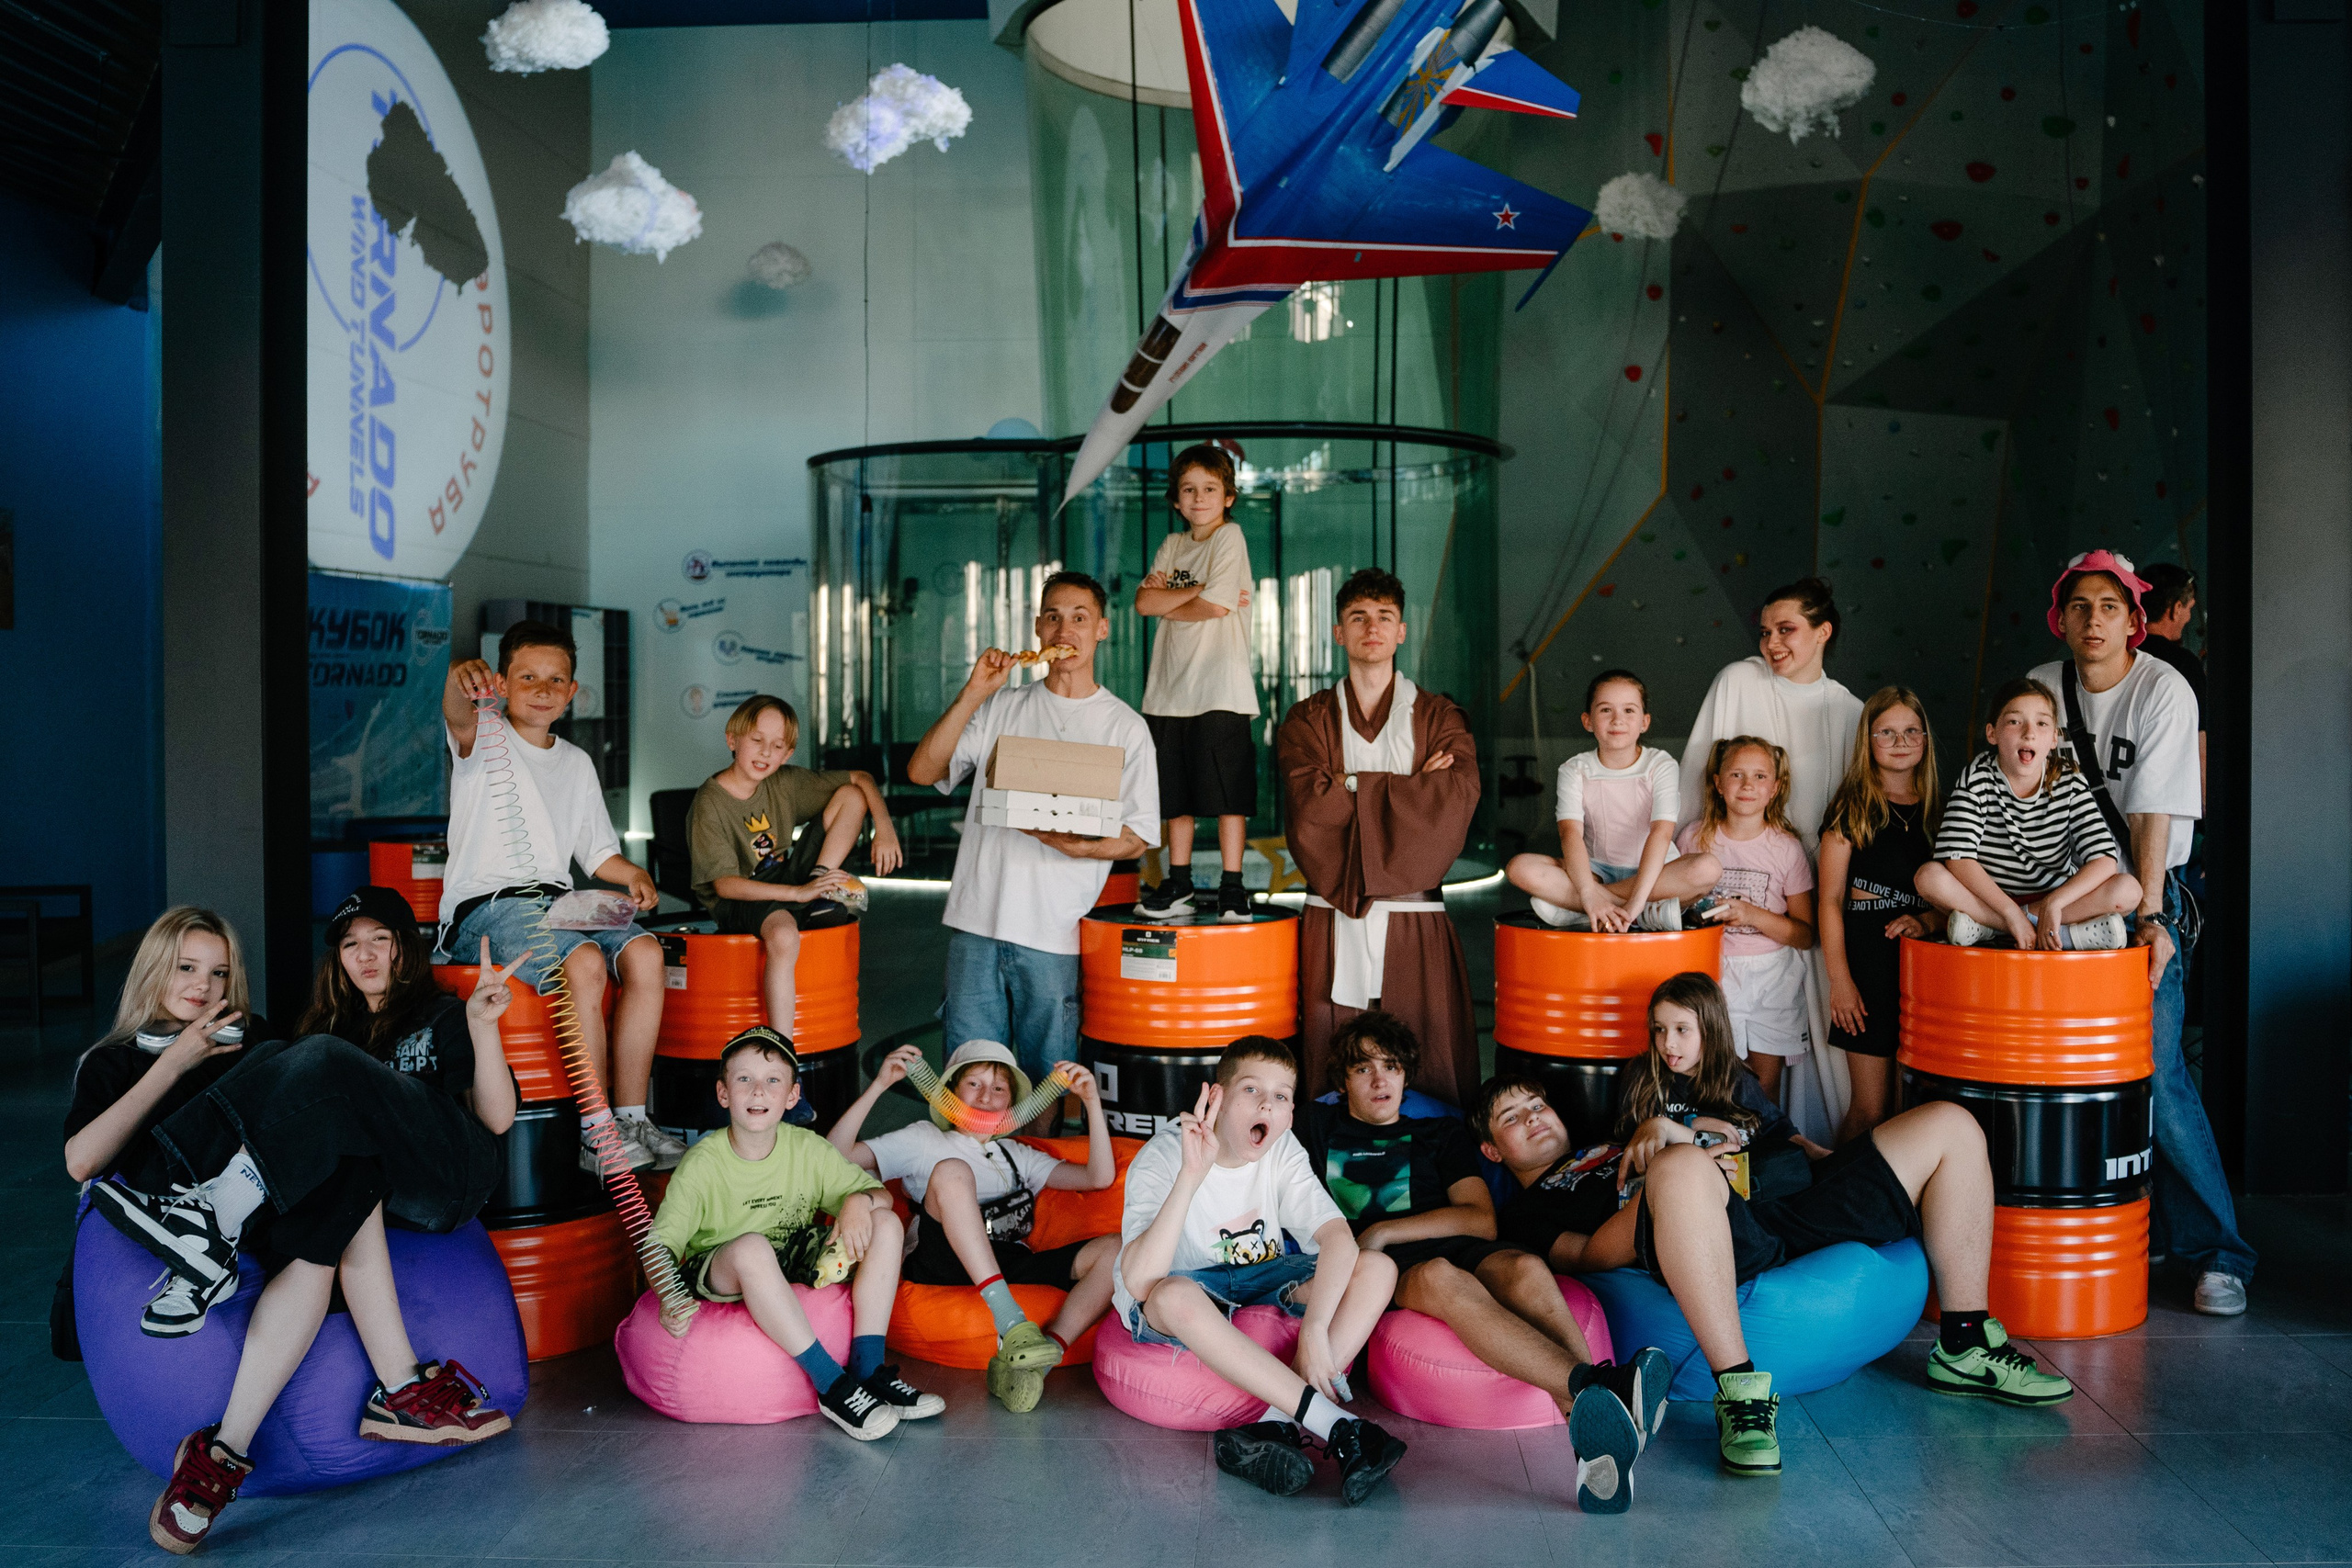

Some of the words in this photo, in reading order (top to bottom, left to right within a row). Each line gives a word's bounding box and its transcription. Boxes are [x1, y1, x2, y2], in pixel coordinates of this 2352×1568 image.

[351, 195, 366, 309] WIND
[349, 319, 366, 519] TUNNELS
[310, 662, 406, 687] ORNADO
[1869, 882, 1891, 897] LOVE
[1851, 901, 1871, 910] LOVE
[1873, 899, 1897, 910] LOVE
[1102, 1109, 1182, 1134] REK
[2105, 1146, 2152, 1180] INT
